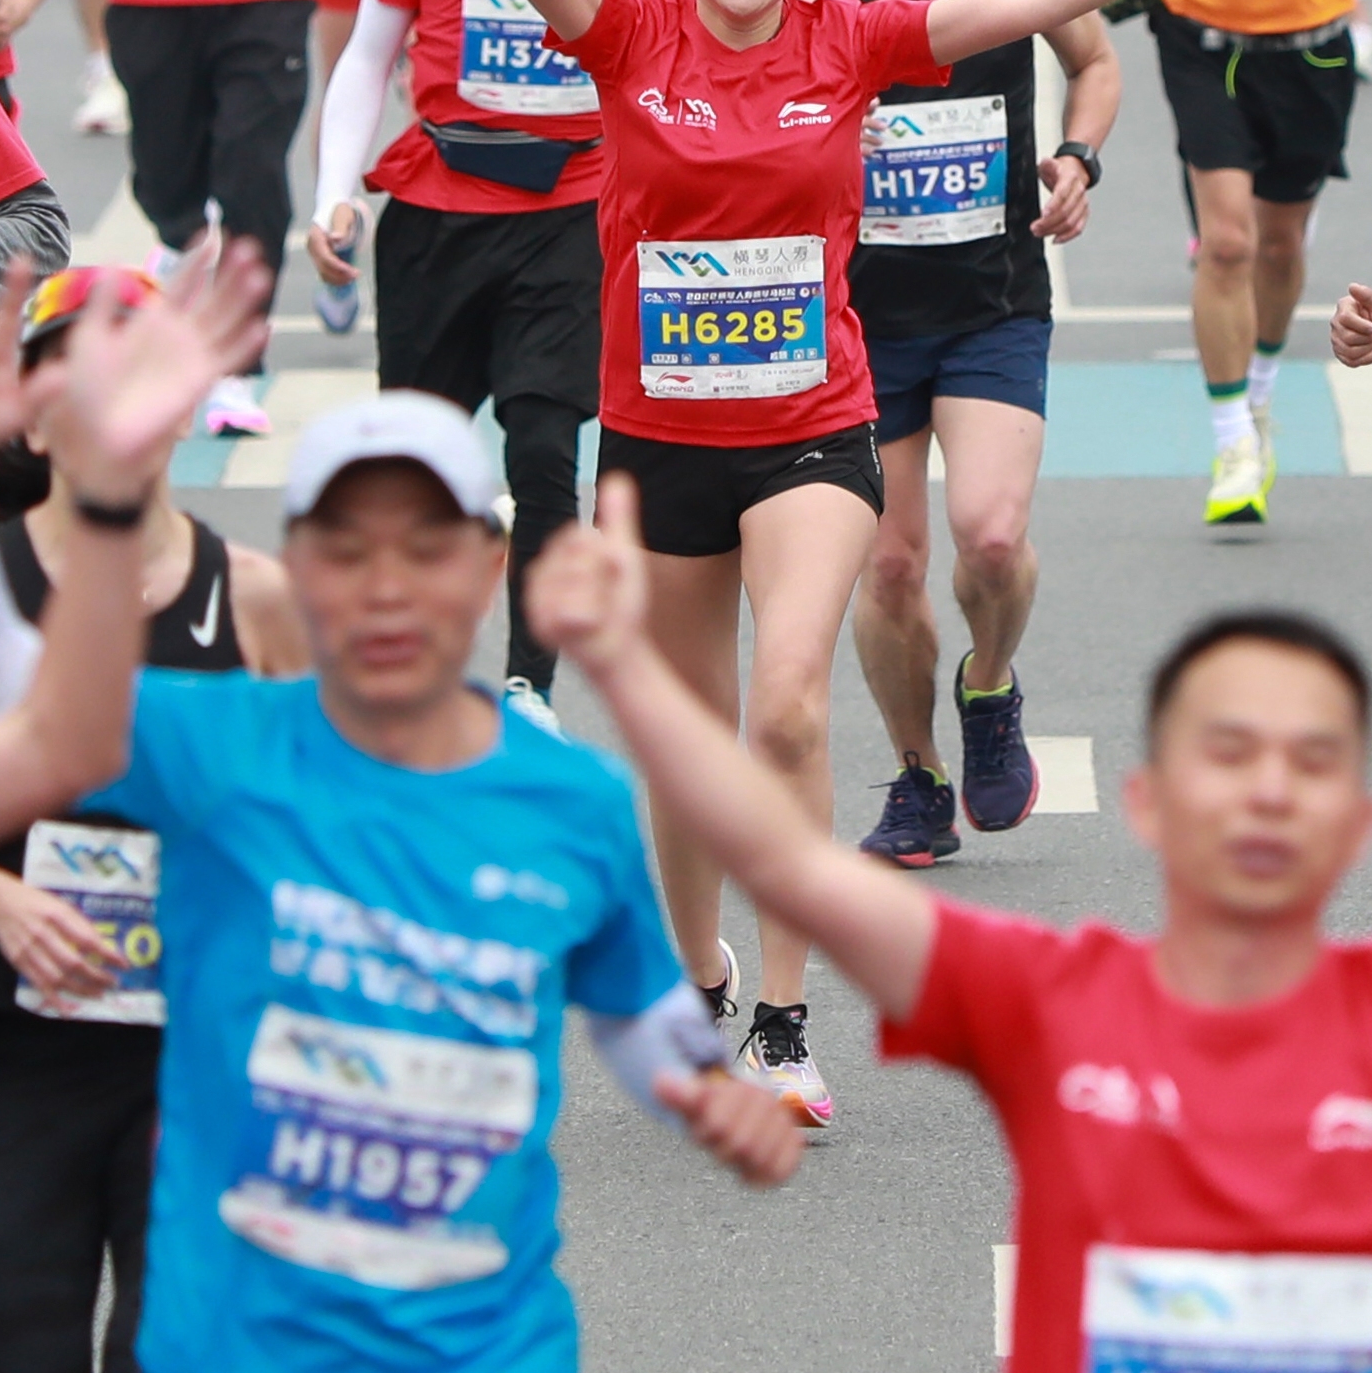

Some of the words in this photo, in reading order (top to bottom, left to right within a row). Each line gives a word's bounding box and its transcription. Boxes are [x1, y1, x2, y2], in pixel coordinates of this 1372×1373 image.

[480, 37, 578, 69] H374
[872, 161, 988, 199] H1785
[662, 308, 806, 345] H6285
[269, 1118, 493, 1214] H1957
